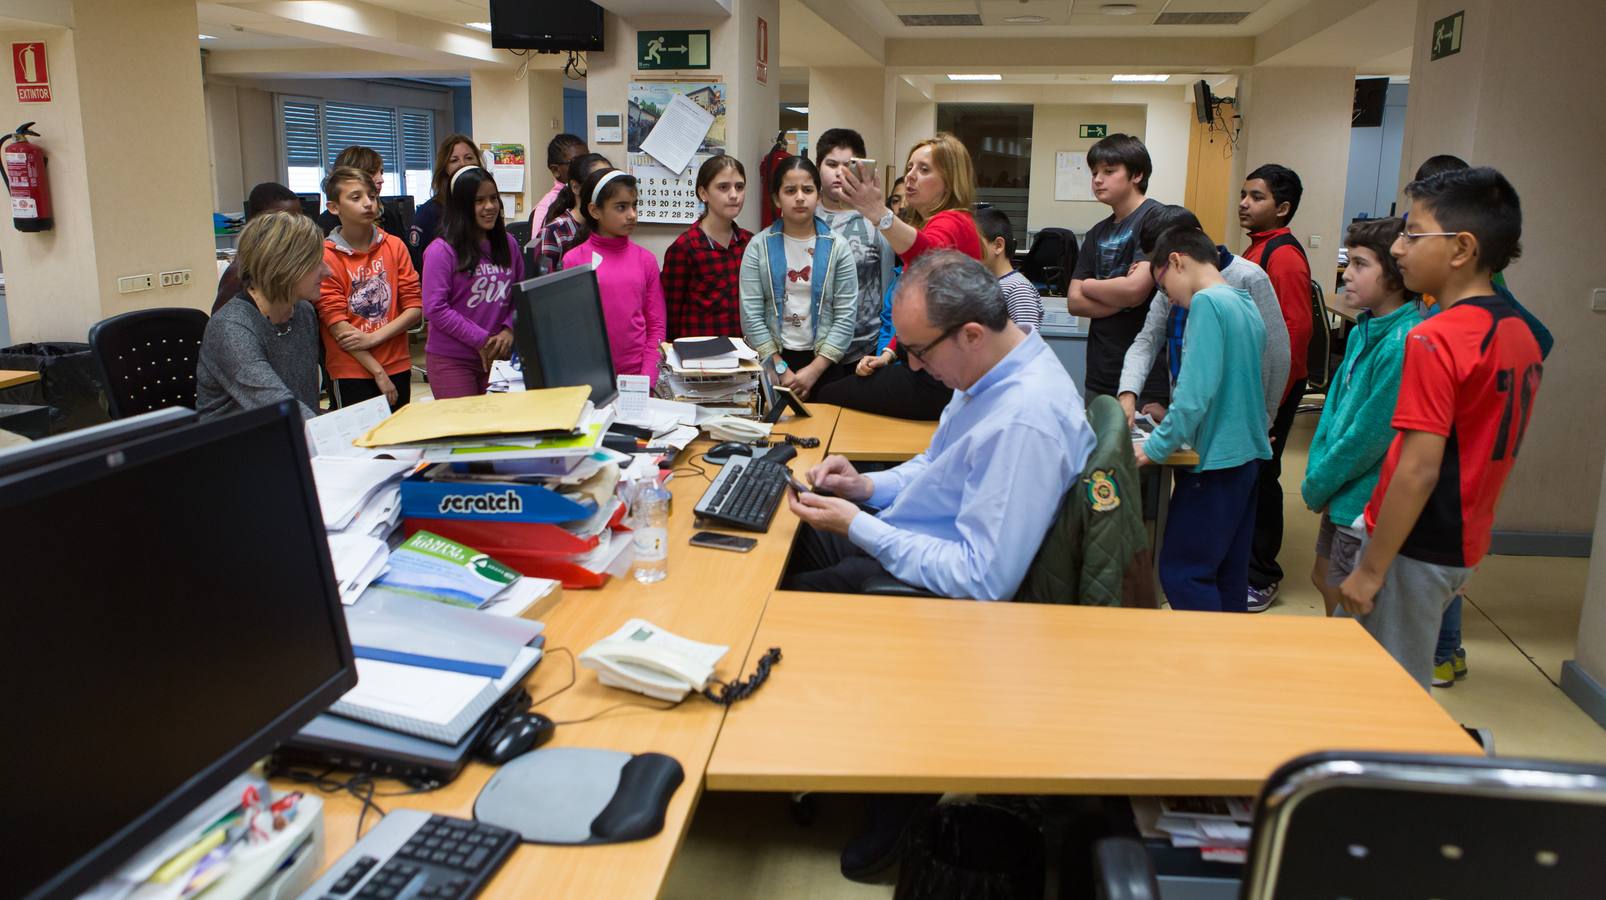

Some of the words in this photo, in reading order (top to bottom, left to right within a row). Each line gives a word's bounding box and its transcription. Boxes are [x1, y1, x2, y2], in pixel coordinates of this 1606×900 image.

[19, 88, 50, 99] EXTINTOR
[672, 200, 681, 208] 21
[646, 210, 656, 218] 26
[659, 210, 669, 218] 27
[671, 211, 681, 219] 28
[467, 275, 512, 308] Six
[439, 490, 523, 514] scratch
